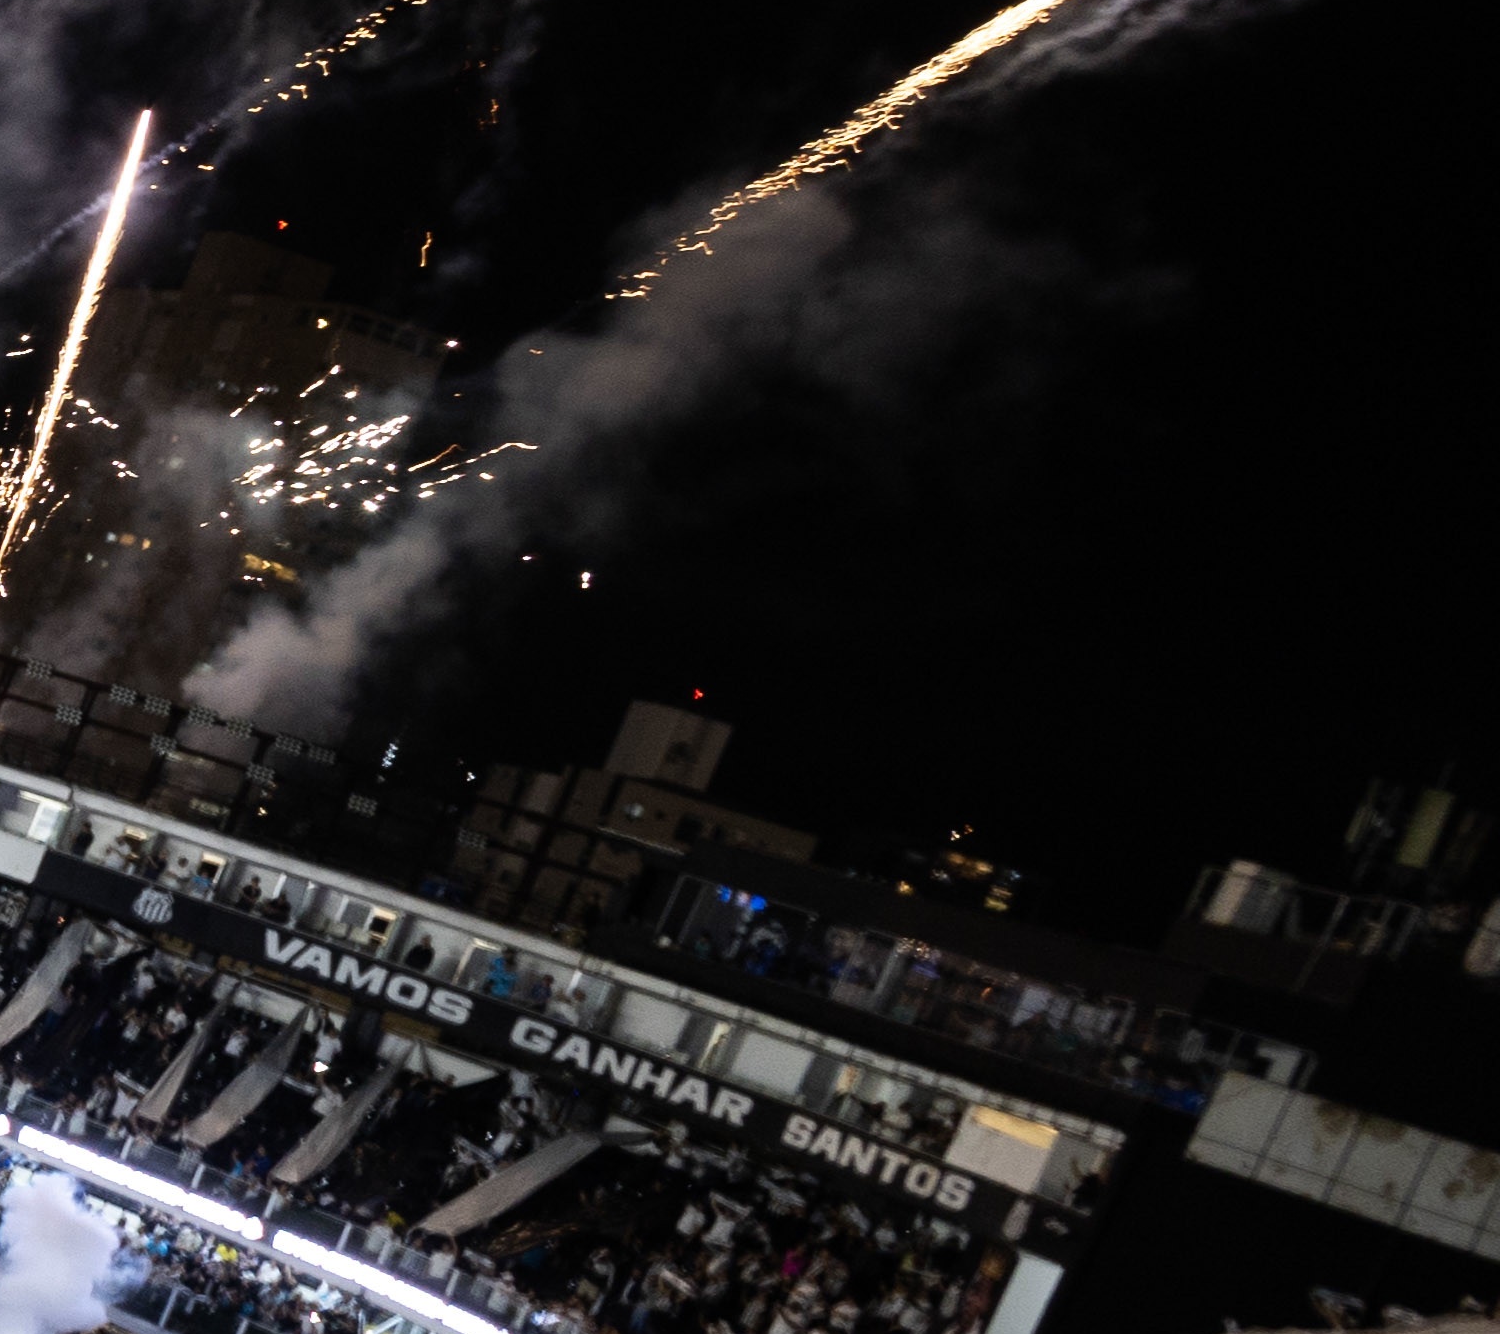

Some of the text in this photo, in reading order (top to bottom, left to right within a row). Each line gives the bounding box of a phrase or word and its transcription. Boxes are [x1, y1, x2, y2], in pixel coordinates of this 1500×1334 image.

[263, 929, 974, 1210] VAMOS GANHAR SANTOS
